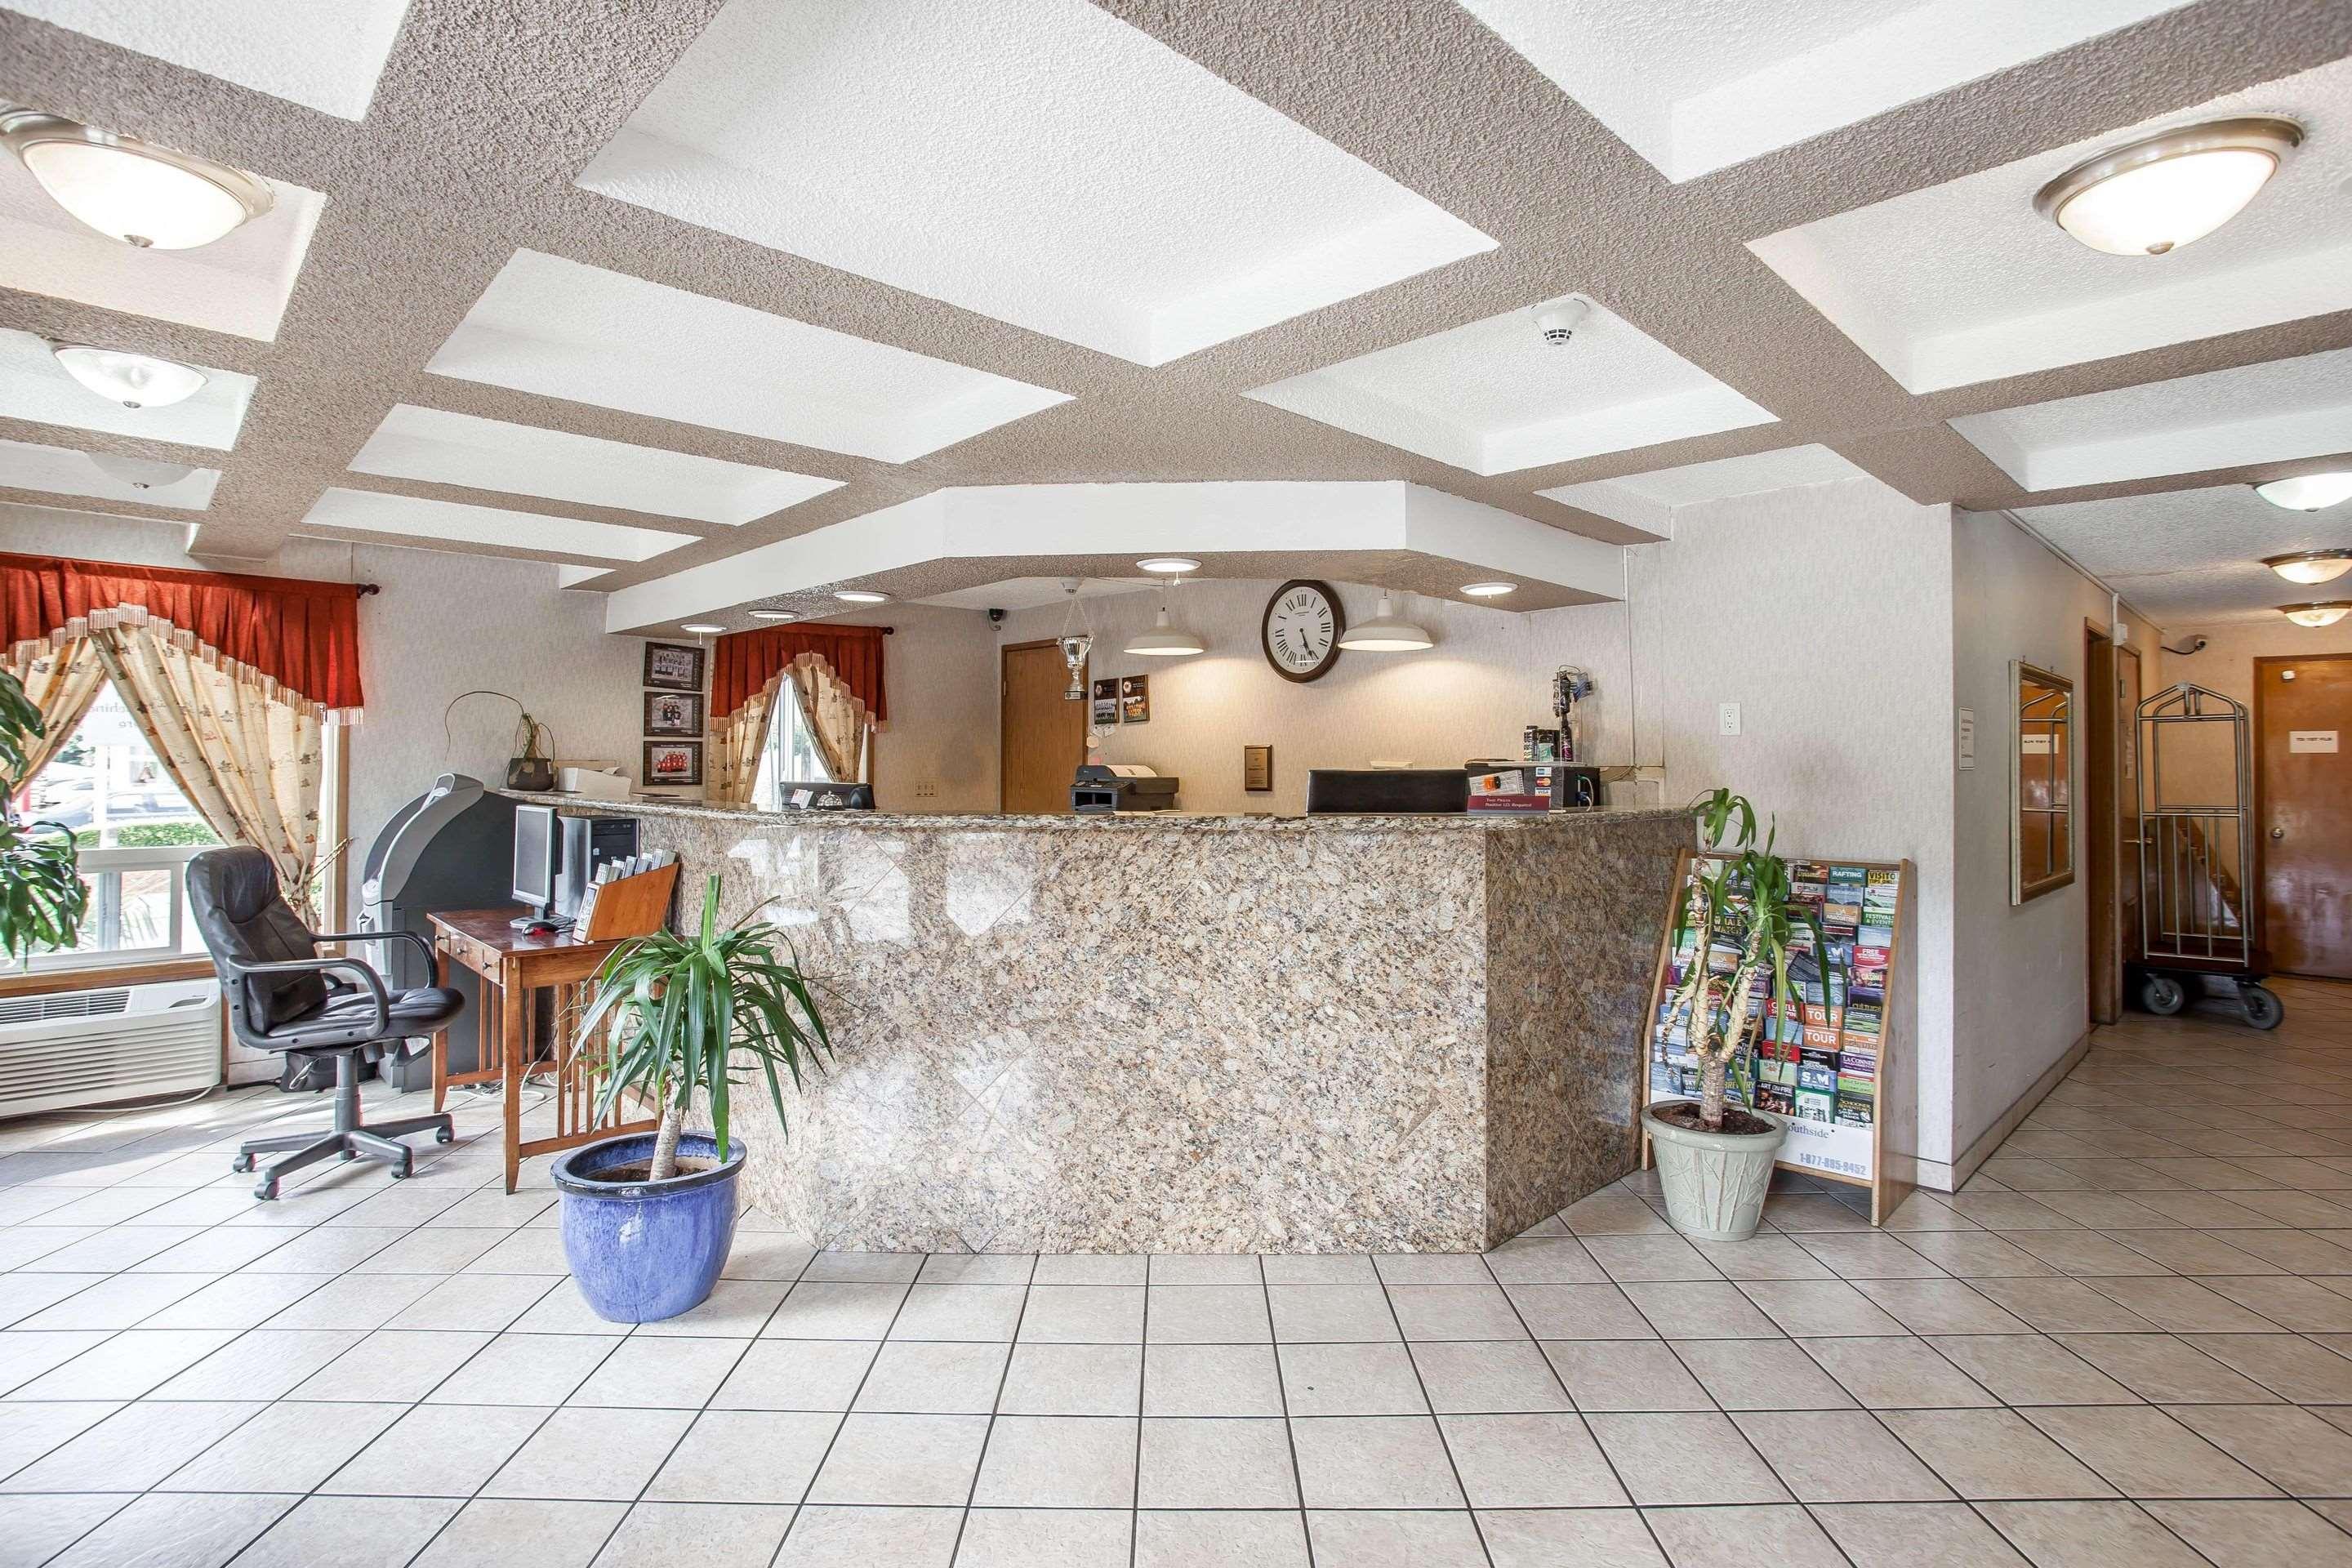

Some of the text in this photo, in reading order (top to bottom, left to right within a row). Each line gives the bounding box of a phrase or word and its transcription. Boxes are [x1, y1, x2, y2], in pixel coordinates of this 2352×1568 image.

[1869, 871, 1896, 880] VISITO
[1806, 1031, 1837, 1045] TOUR
[1788, 1124, 1830, 1138] outhside
